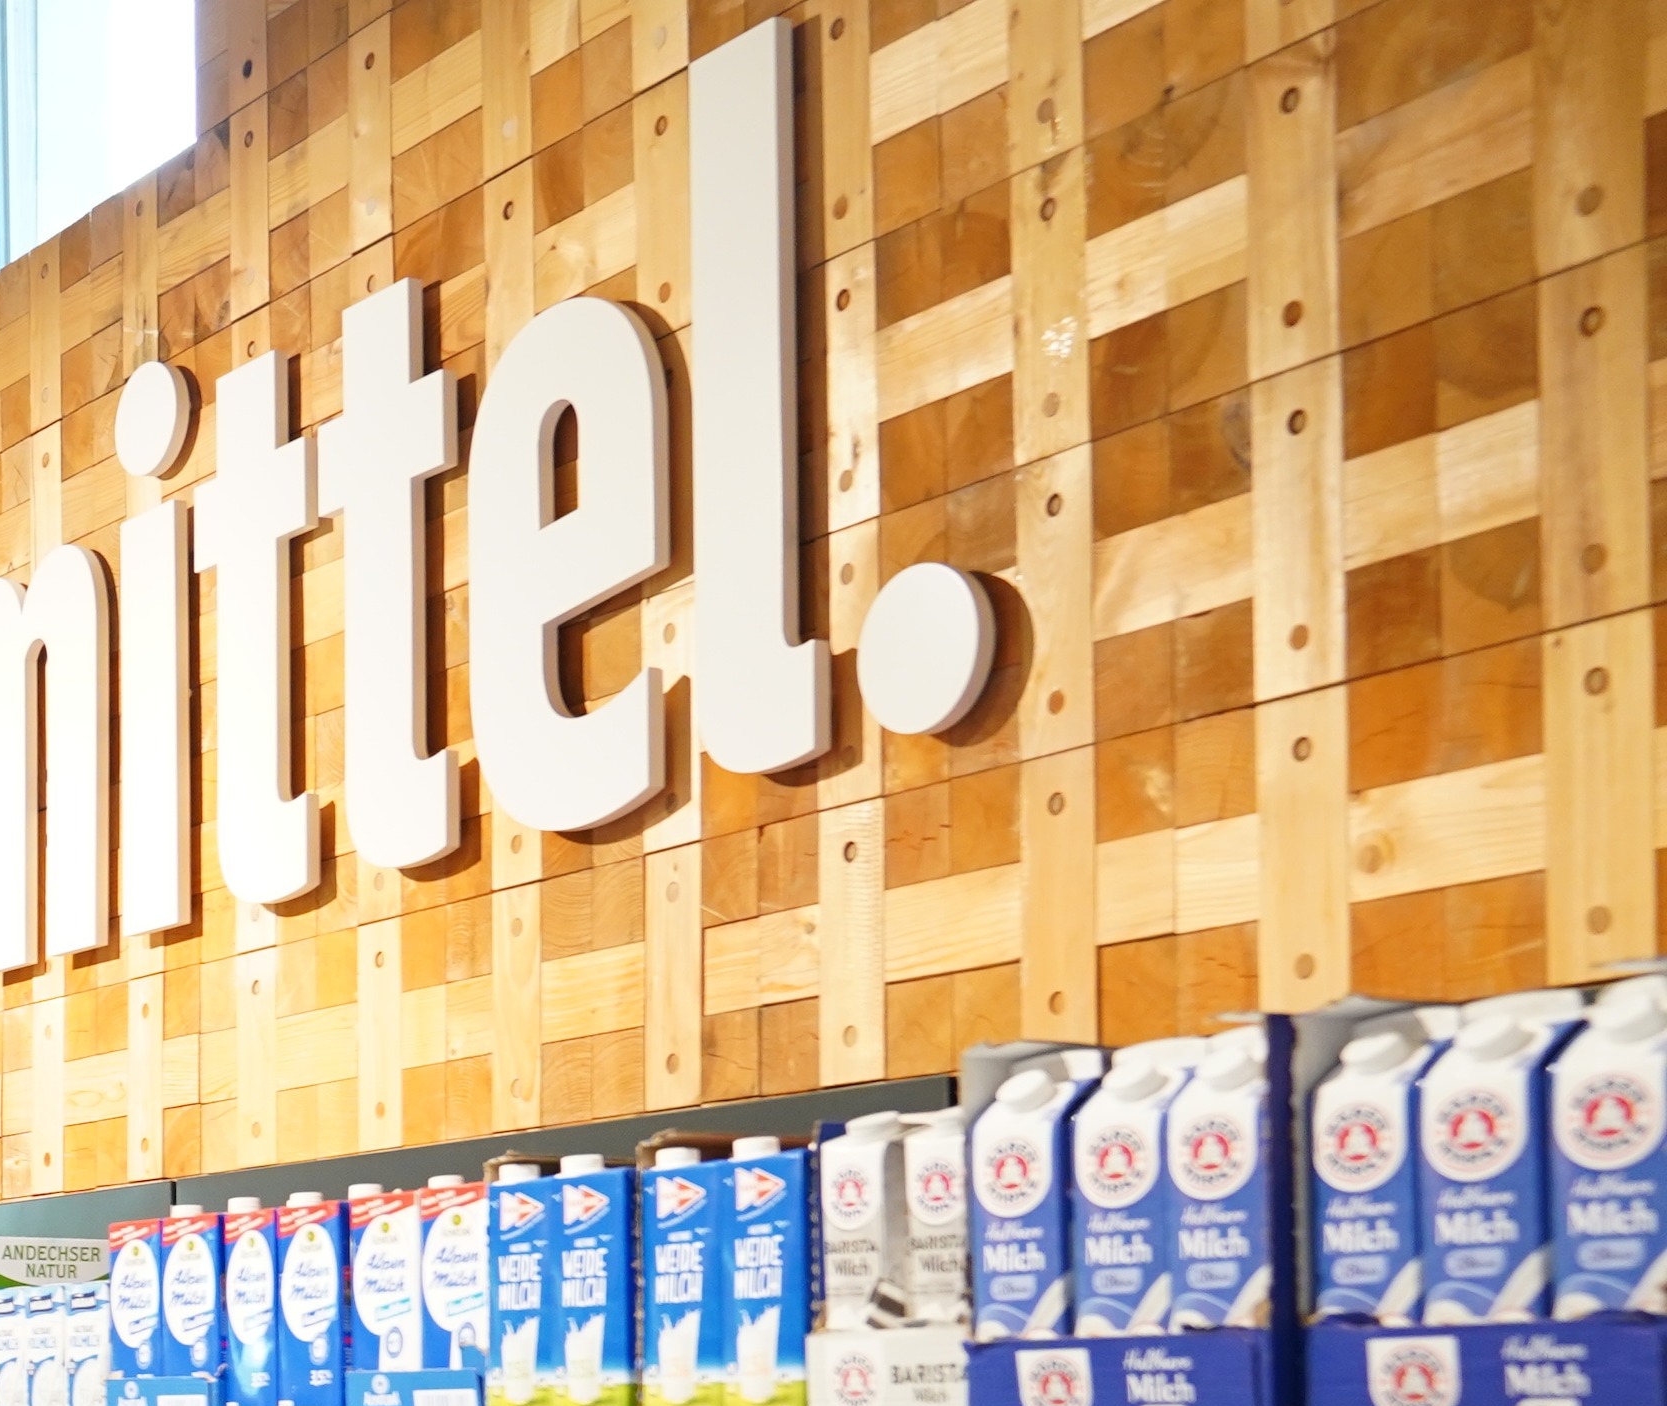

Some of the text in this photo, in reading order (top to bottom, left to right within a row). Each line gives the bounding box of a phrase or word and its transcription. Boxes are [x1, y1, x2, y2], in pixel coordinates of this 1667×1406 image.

[1434, 1212, 1519, 1244] Milch
[1567, 1202, 1658, 1235] Milch
[1179, 1228, 1249, 1259] Milch
[1322, 1221, 1399, 1250] Milch
[2, 1245, 100, 1262] ANDECHSER
[983, 1245, 1045, 1271] Milch
[1085, 1237, 1153, 1265] Milch
[26, 1264, 77, 1279] NATUR
[733, 1268, 782, 1300] MILCH
[498, 1282, 542, 1312] MILCH
[561, 1277, 607, 1307] MILCH
[654, 1273, 703, 1303] MILCH
[891, 1365, 968, 1386] BARISTA
[1125, 1372, 1195, 1403] Milch
[1505, 1361, 1591, 1400] Milch
